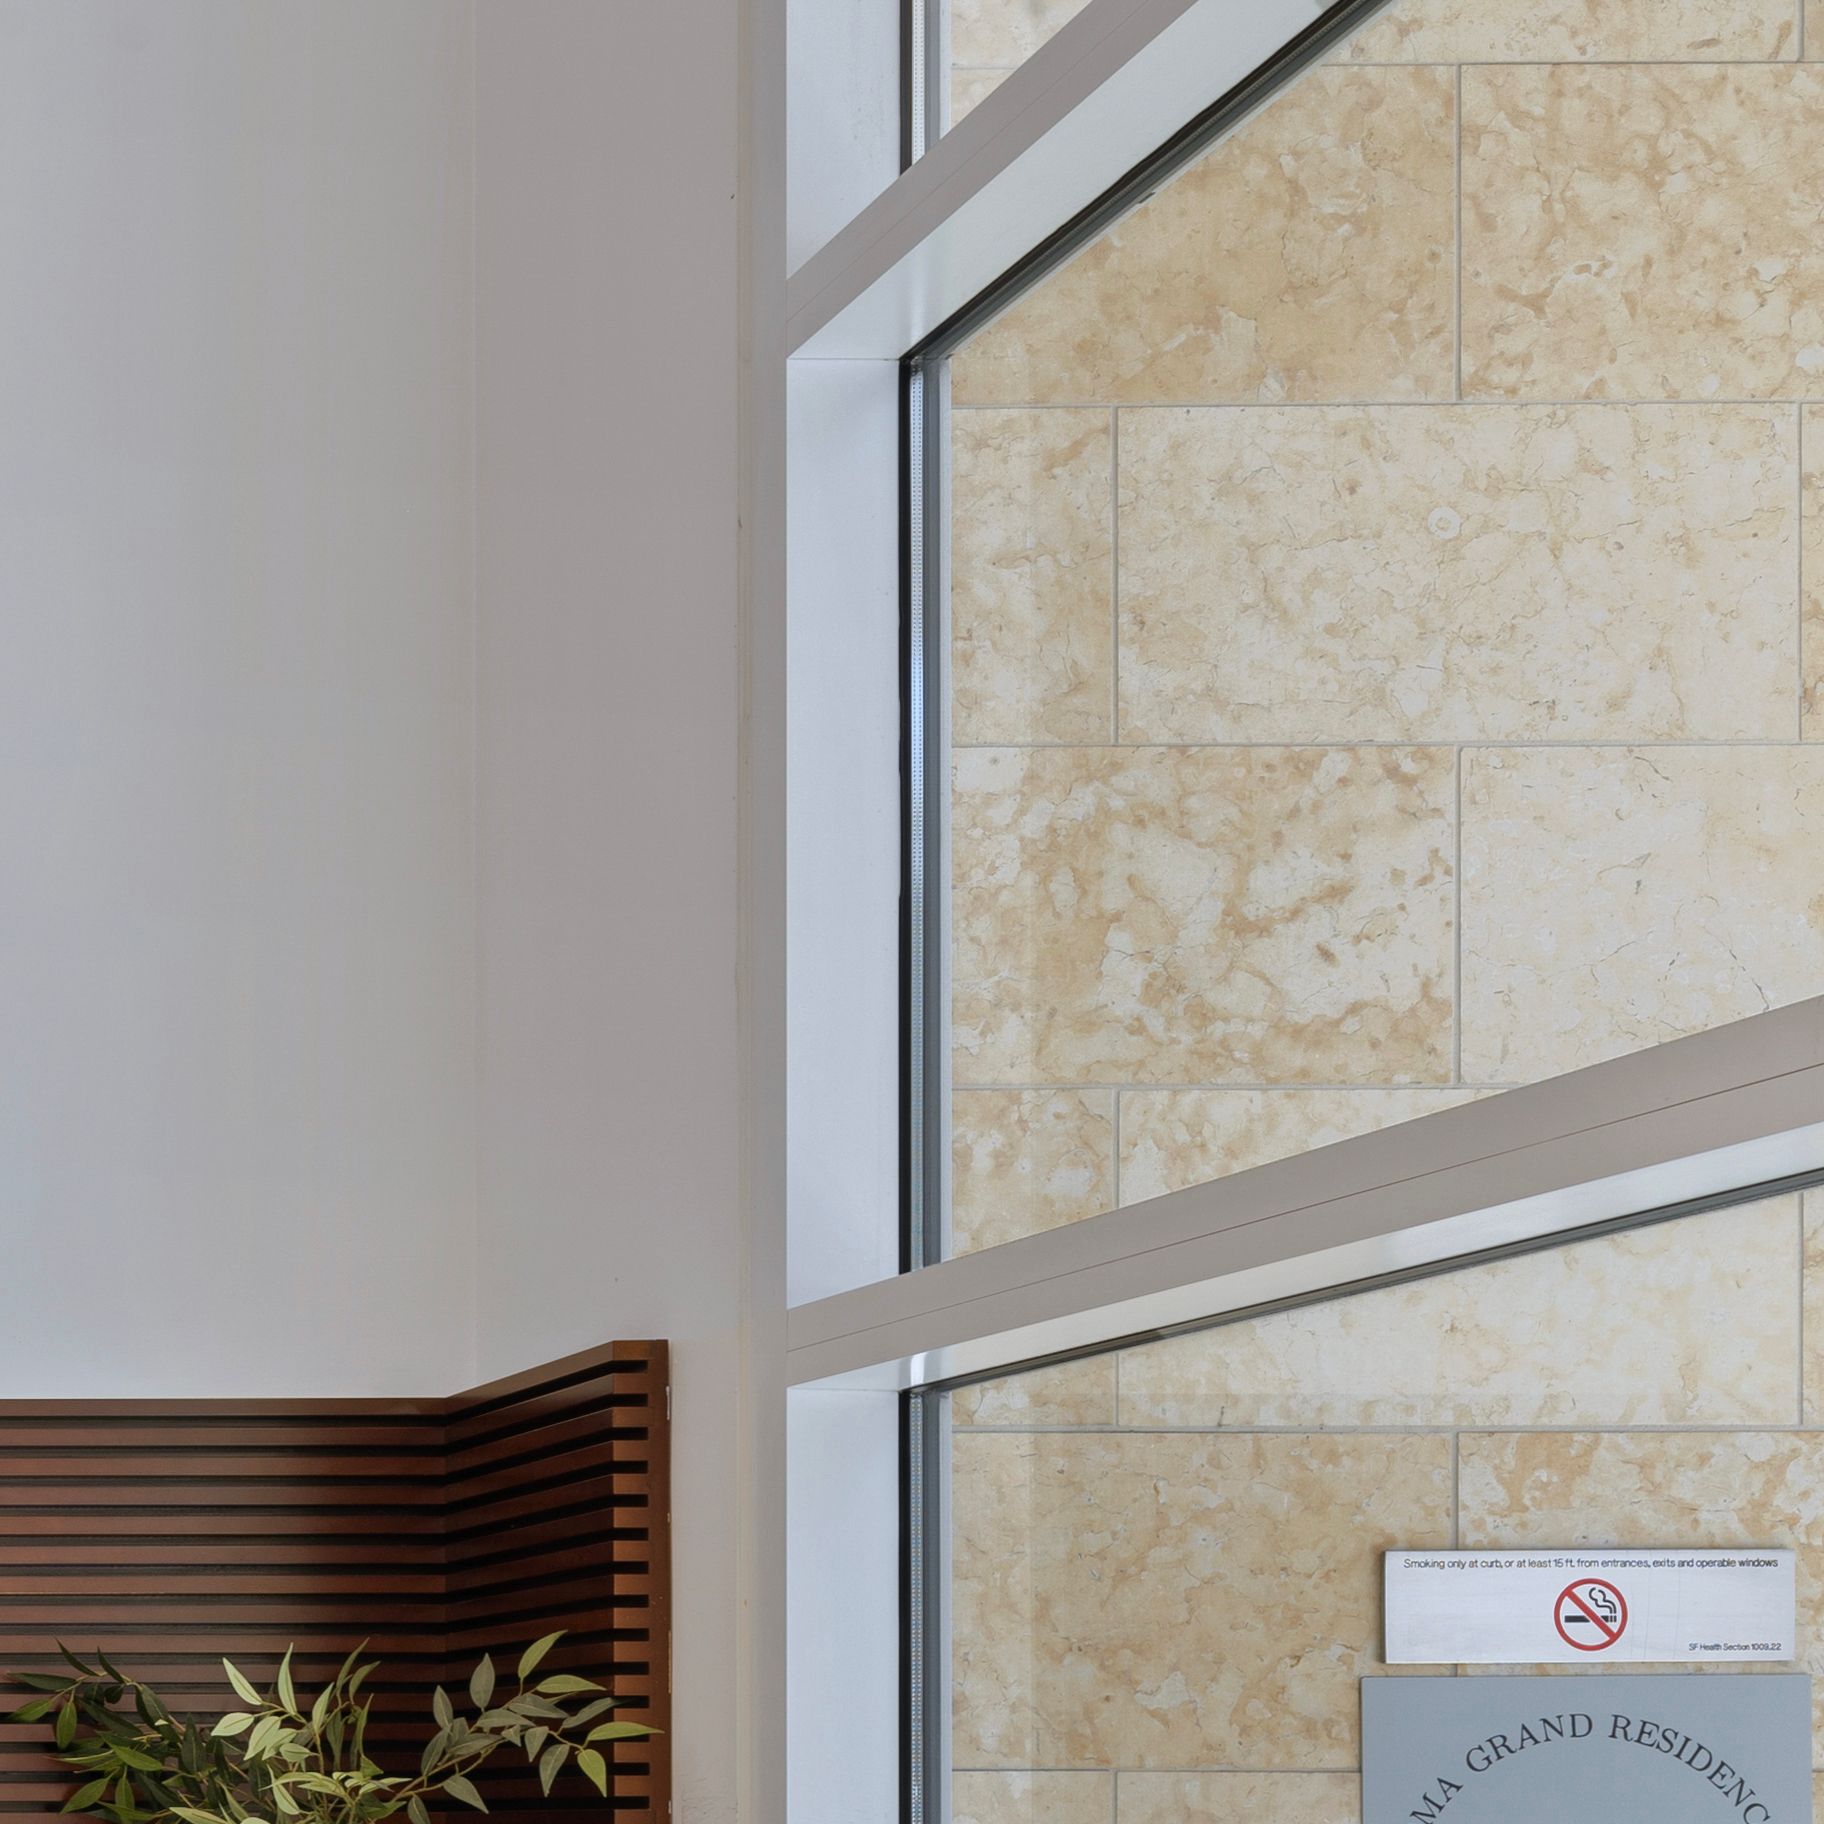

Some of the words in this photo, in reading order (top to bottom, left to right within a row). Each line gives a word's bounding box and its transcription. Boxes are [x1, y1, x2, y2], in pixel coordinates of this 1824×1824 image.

[1404, 1559, 1445, 1569] Smoking
[1447, 1559, 1466, 1570] only
[1469, 1559, 1478, 1568] at
[1481, 1559, 1502, 1568] curb,
[1505, 1560, 1514, 1568] or
[1516, 1560, 1526, 1568] at
[1528, 1559, 1551, 1568] least
[1553, 1559, 1563, 1567] 15
[1577, 1559, 1599, 1567] from
[1601, 1559, 1651, 1568] entrances,
[1652, 1559, 1675, 1567] exits
[1678, 1559, 1694, 1567] and
[1696, 1559, 1736, 1568] operable
[1739, 1558, 1778, 1567] windows
[1466, 1713, 1592, 1772] GRAND
